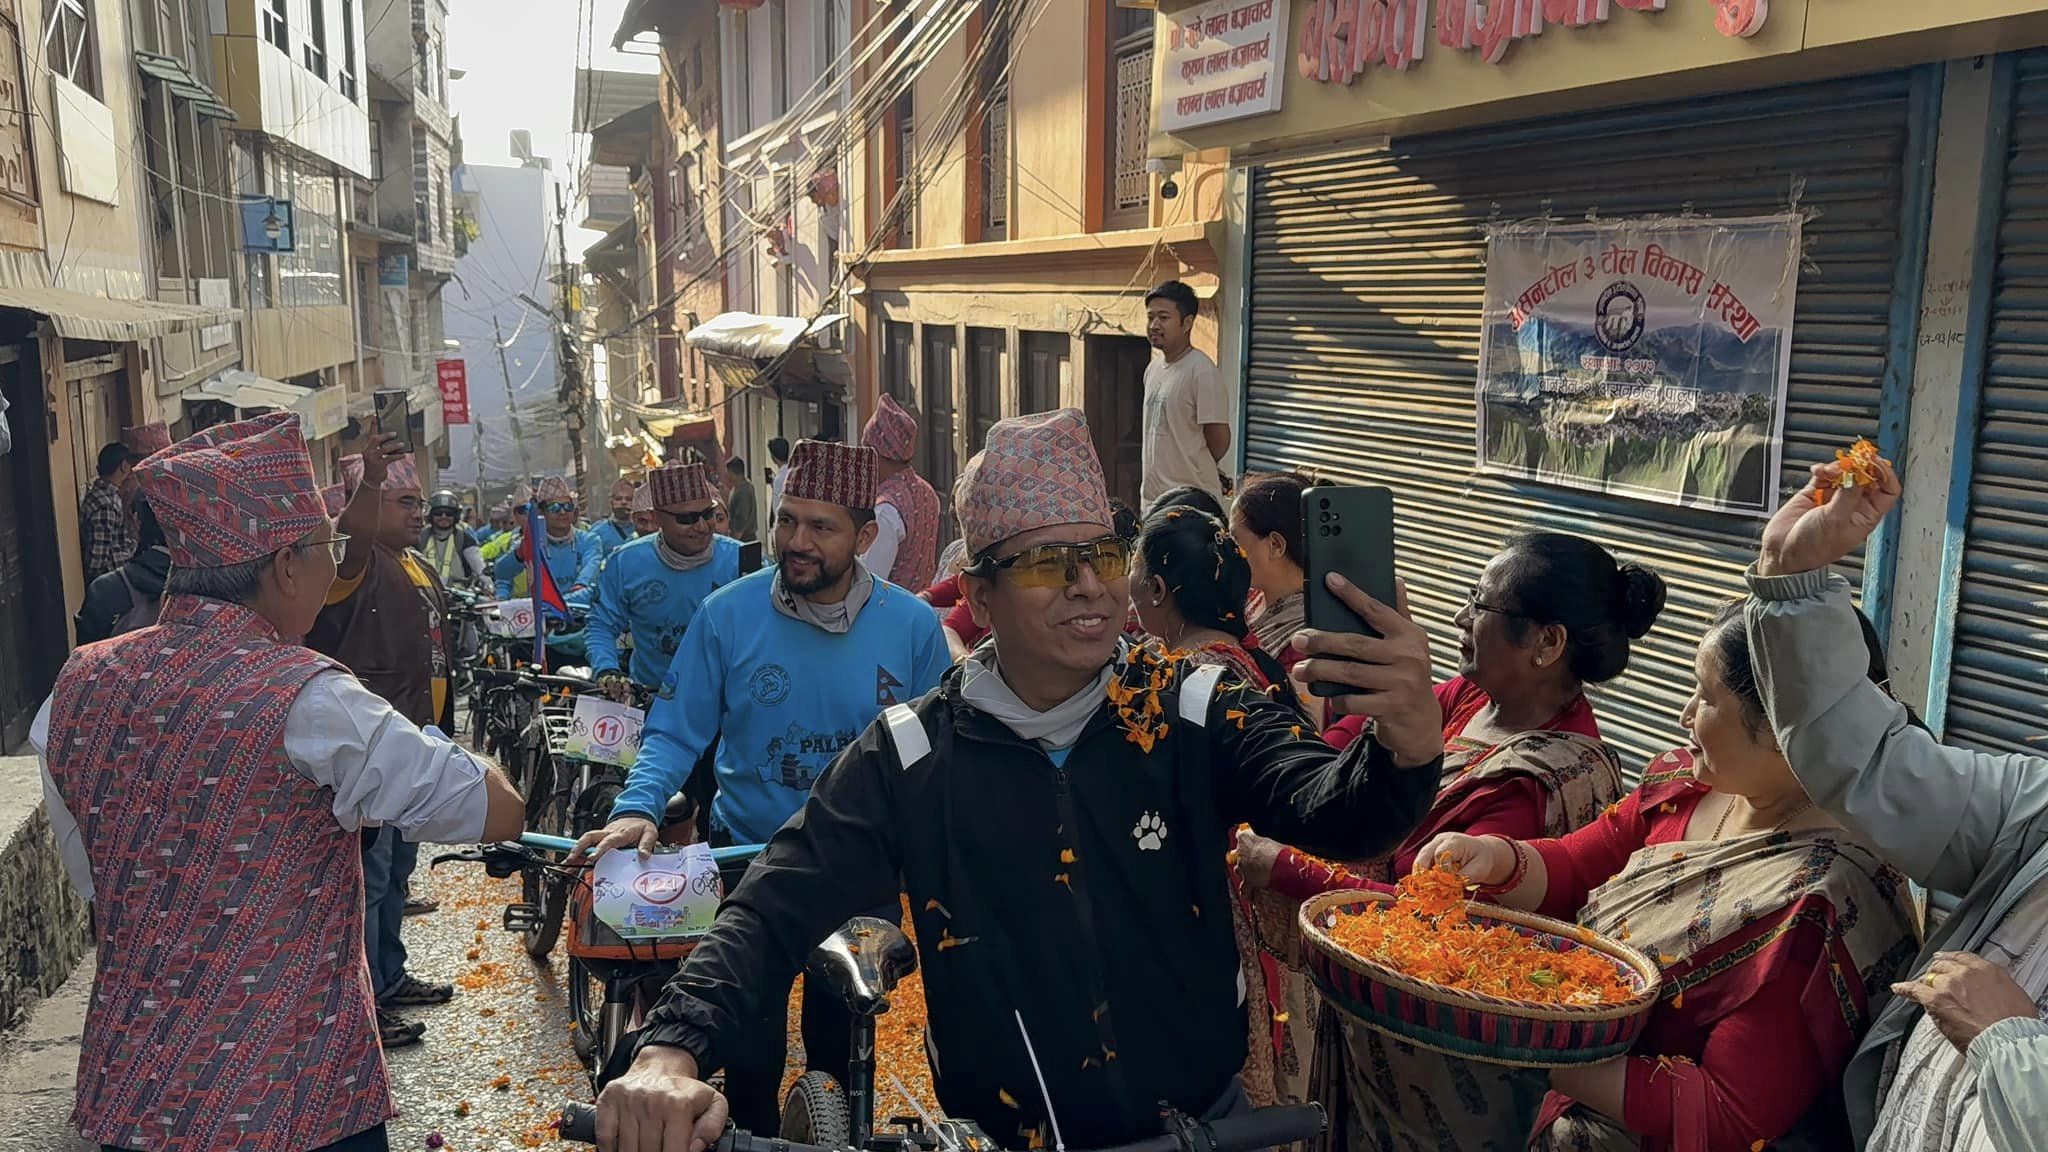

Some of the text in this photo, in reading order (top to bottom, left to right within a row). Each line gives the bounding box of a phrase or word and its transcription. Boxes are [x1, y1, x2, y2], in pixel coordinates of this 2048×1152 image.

[1205, 13, 1229, 39] लाल
[1207, 50, 1229, 75] लाल
[1205, 87, 1228, 112] लाल
[1583, 255, 1596, 280] ३
[1600, 244, 1639, 275] टोल
[1642, 243, 1706, 296] विकास
[1706, 279, 1762, 344] संस्था
[517, 612, 529, 625] 6
[597, 721, 619, 742] 11
[799, 736, 855, 754] PALP
